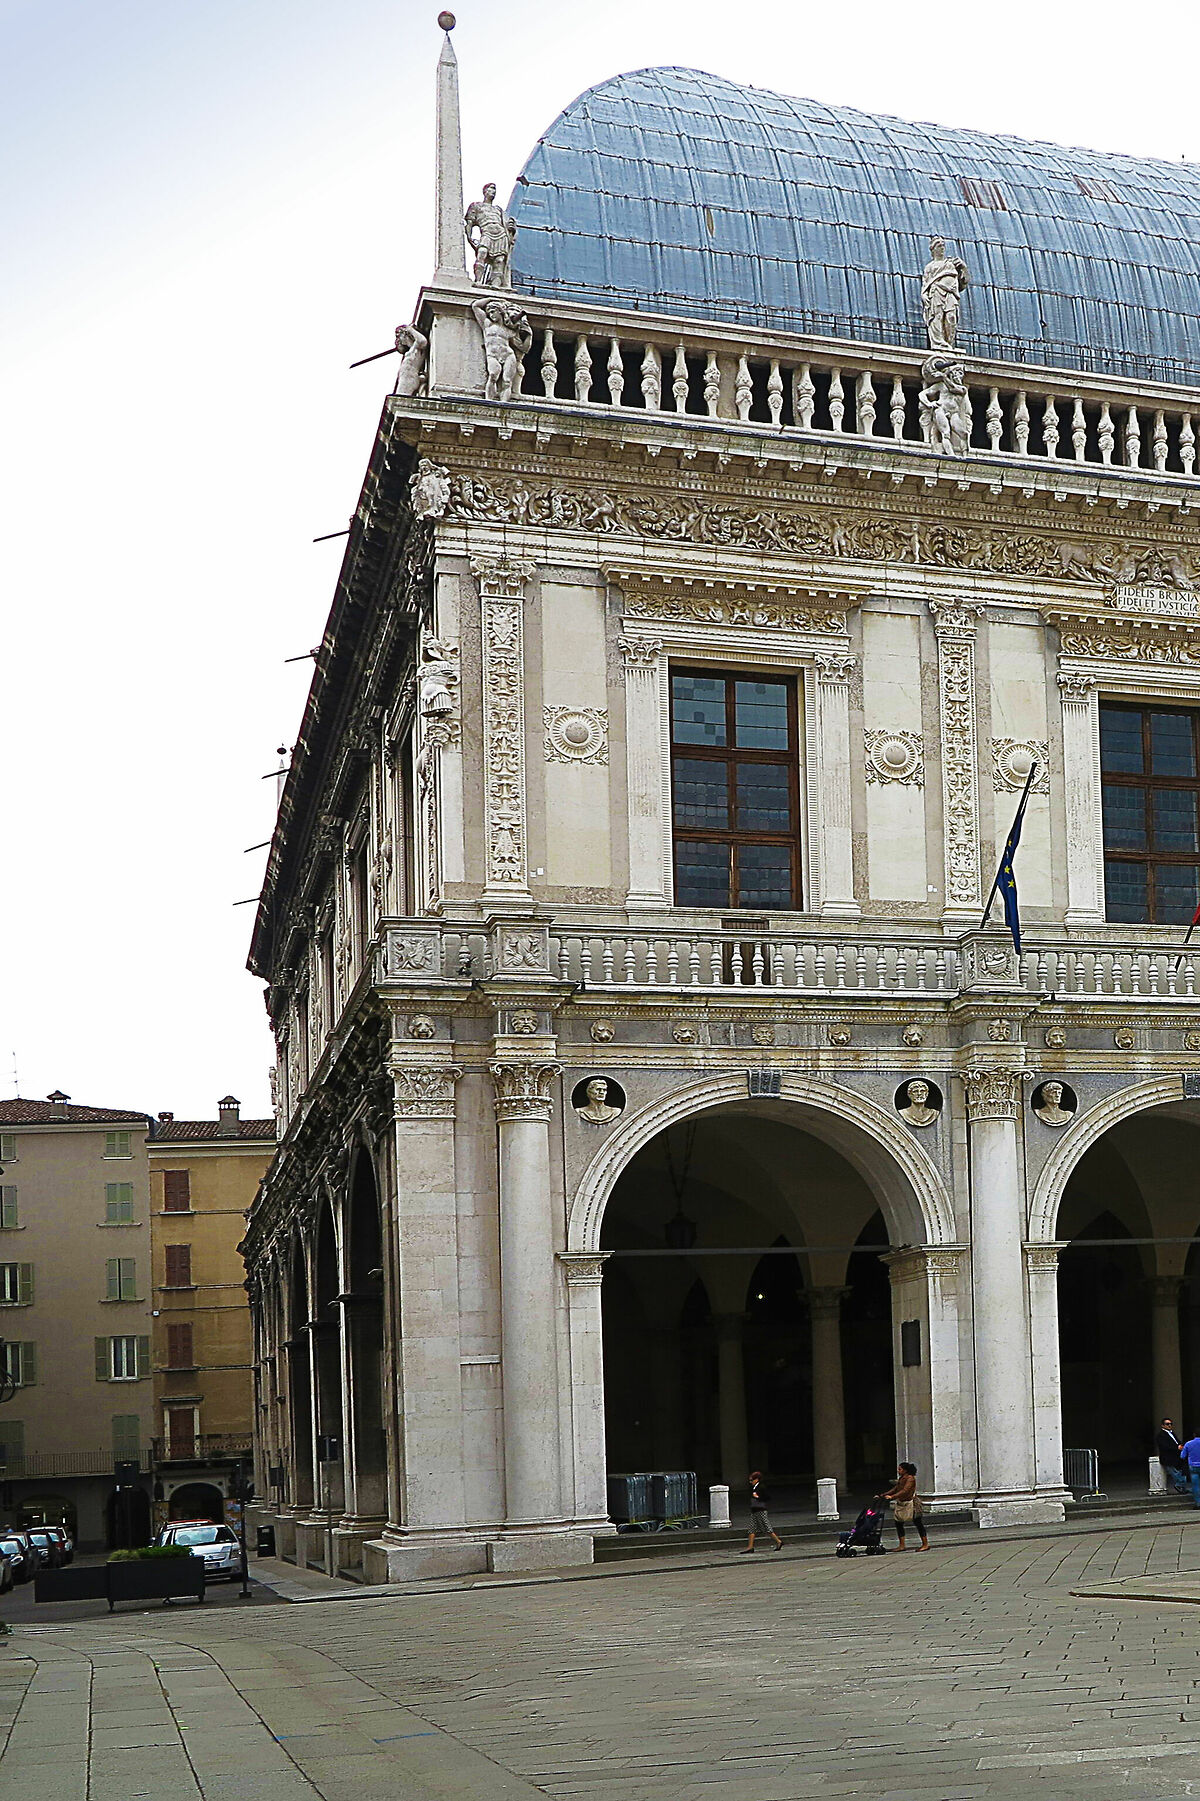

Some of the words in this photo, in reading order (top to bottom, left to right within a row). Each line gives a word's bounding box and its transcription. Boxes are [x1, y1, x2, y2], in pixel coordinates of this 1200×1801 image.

[1117, 586, 1155, 599] FIDELIS
[1158, 590, 1199, 603] BRIXIA
[1118, 596, 1142, 607] FIDEI
[1145, 599, 1155, 608] ET
